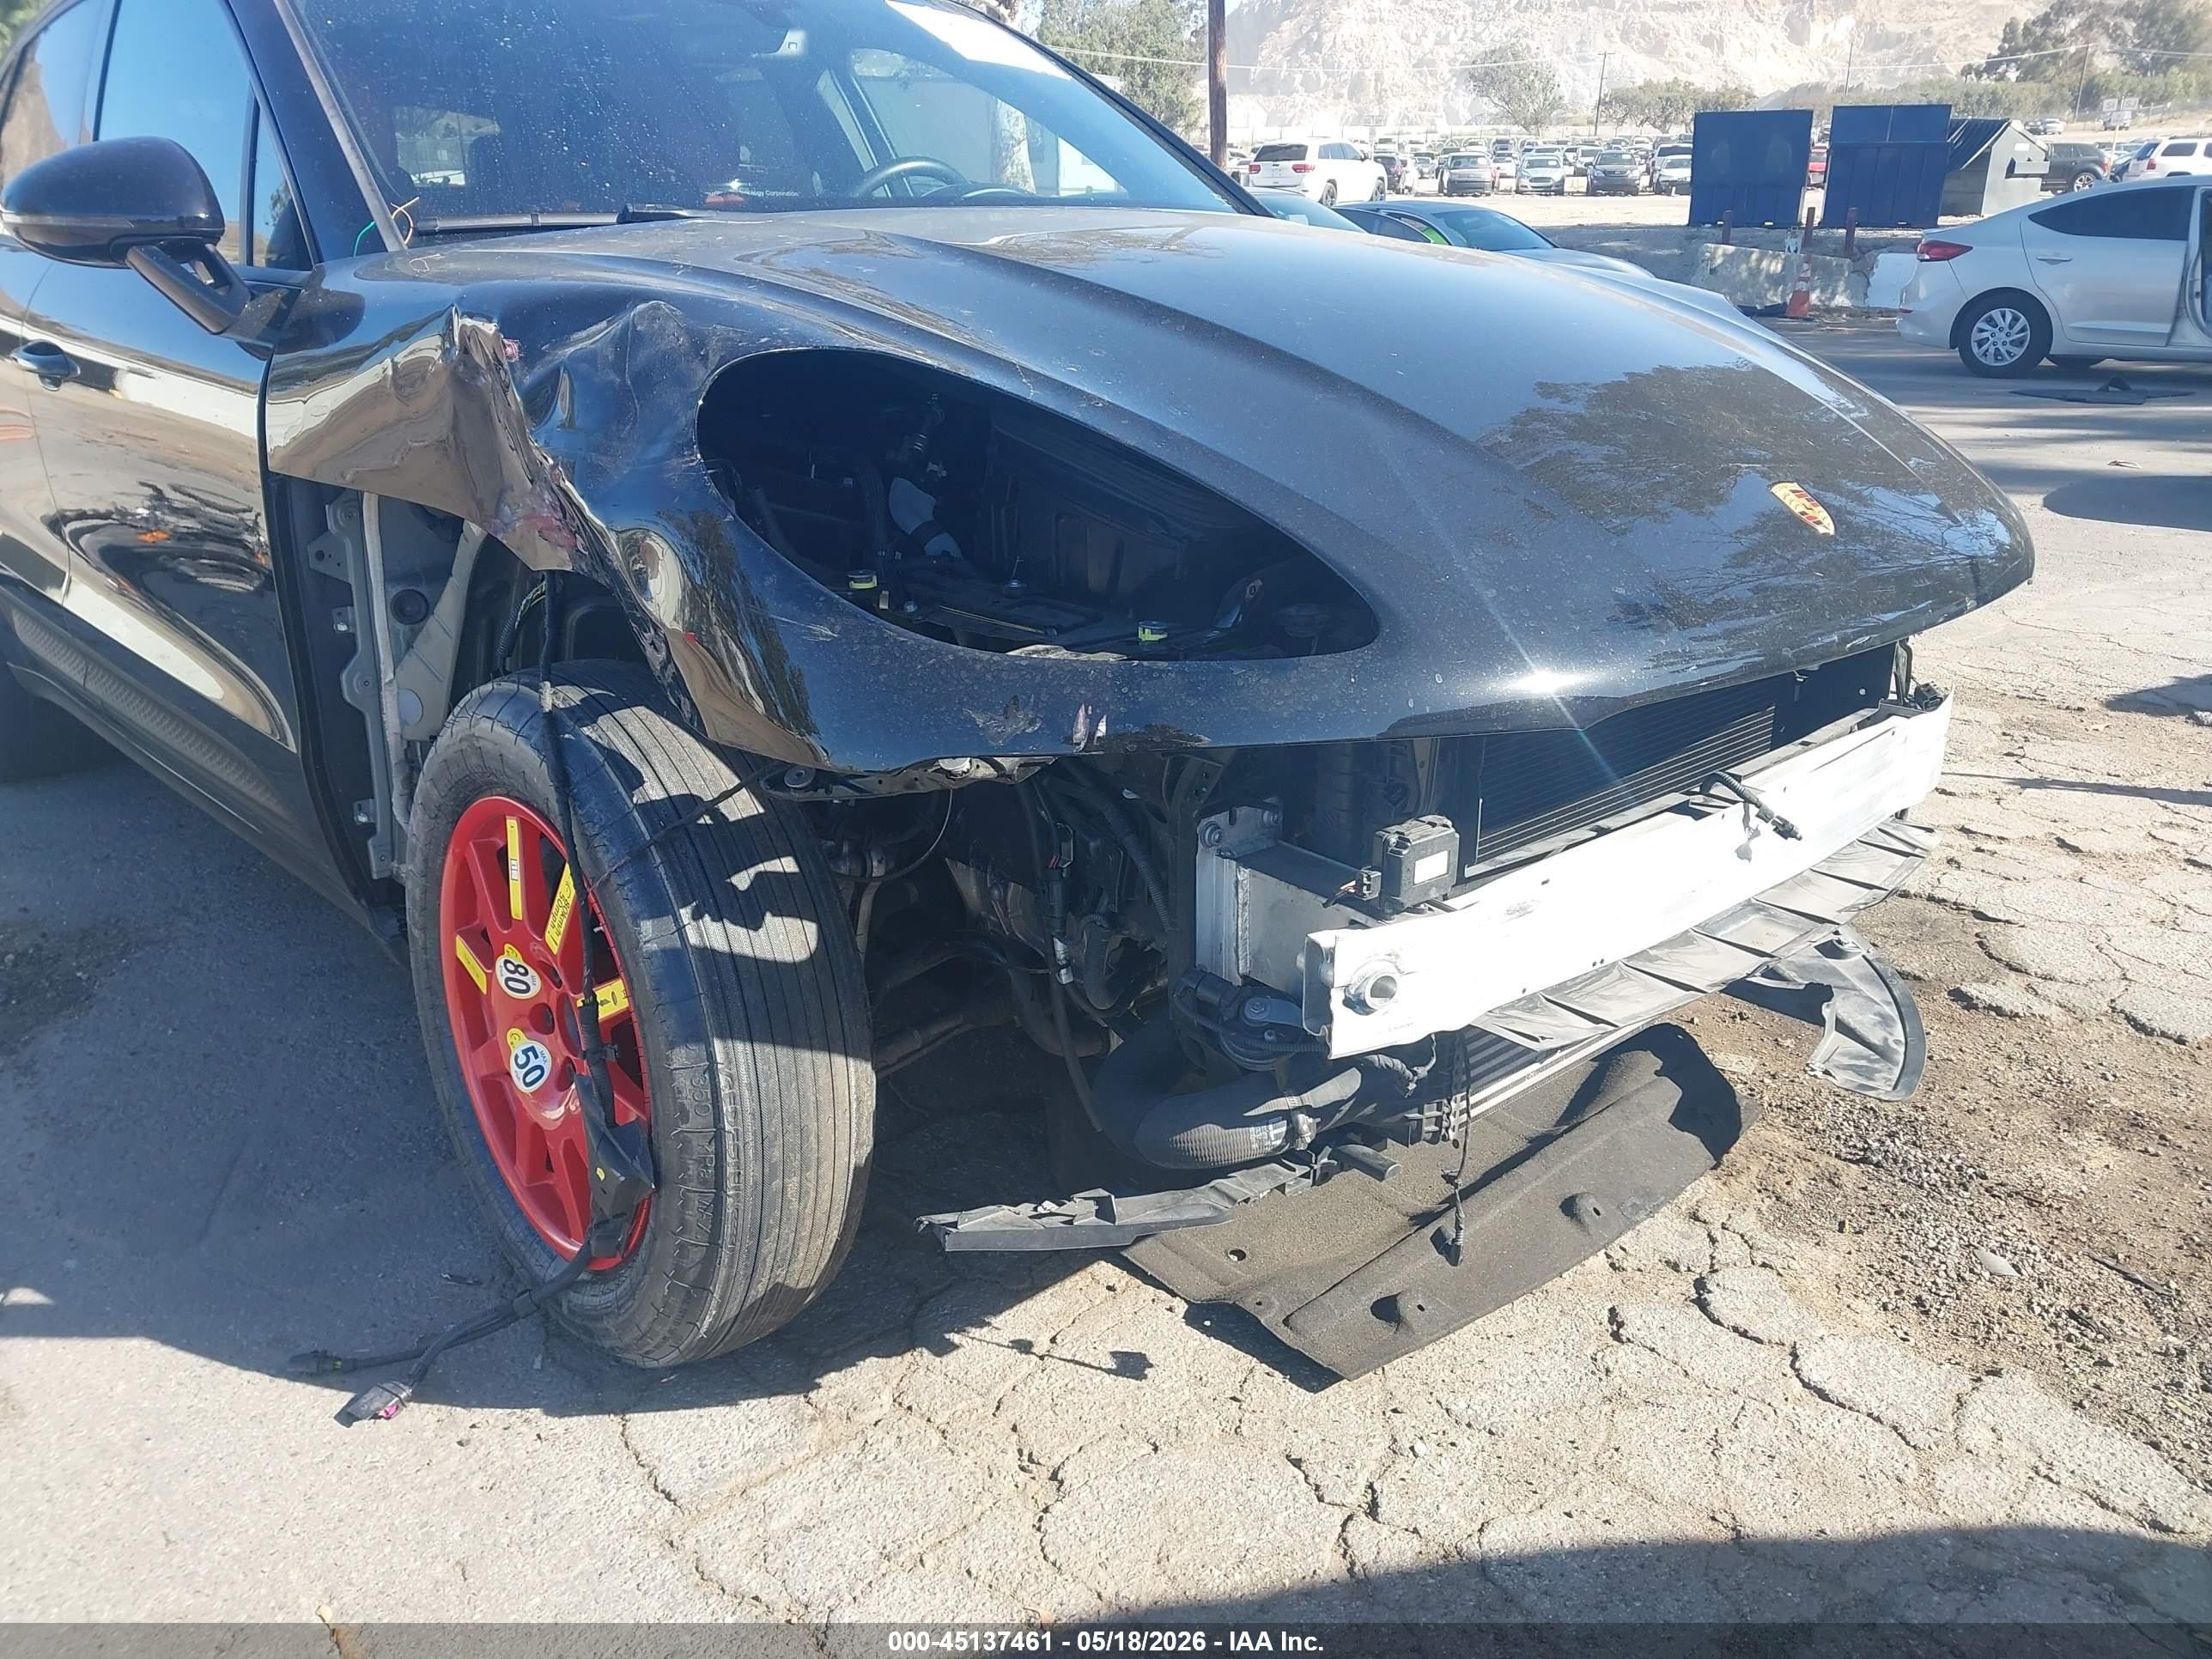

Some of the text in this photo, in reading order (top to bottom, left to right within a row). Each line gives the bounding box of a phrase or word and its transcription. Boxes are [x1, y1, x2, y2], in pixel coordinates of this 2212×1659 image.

[550, 891, 565, 930] 50mph
[503, 958, 531, 994] 80
[514, 1045, 545, 1088] 50
[690, 1073, 711, 1116] 350
